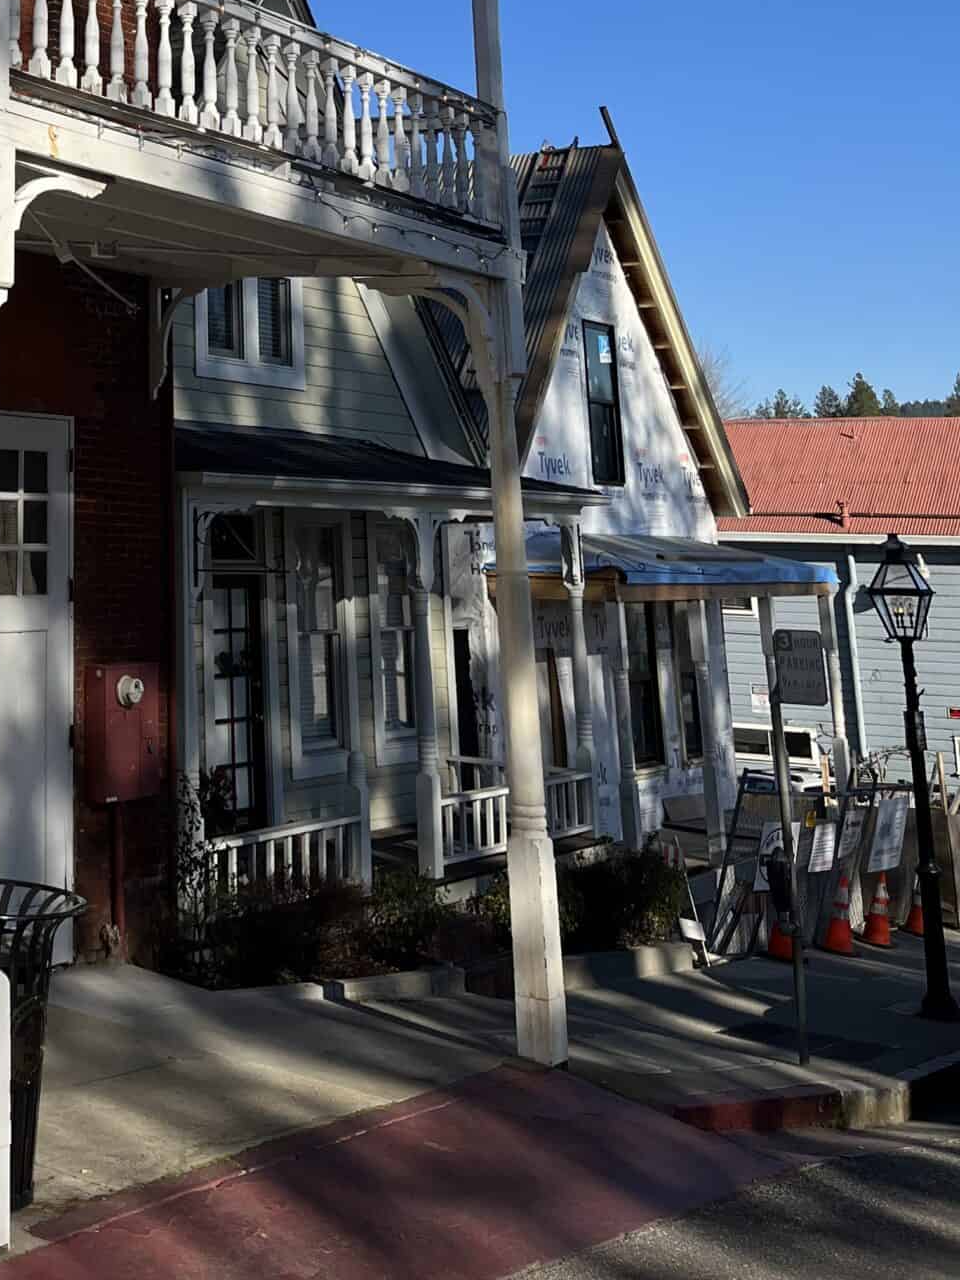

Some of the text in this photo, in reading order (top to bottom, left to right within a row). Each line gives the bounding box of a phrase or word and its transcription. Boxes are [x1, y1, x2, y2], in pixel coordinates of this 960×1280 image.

[537, 451, 571, 481] Tyvek
[636, 462, 664, 489] Tyvek
[778, 631, 790, 649] 3
